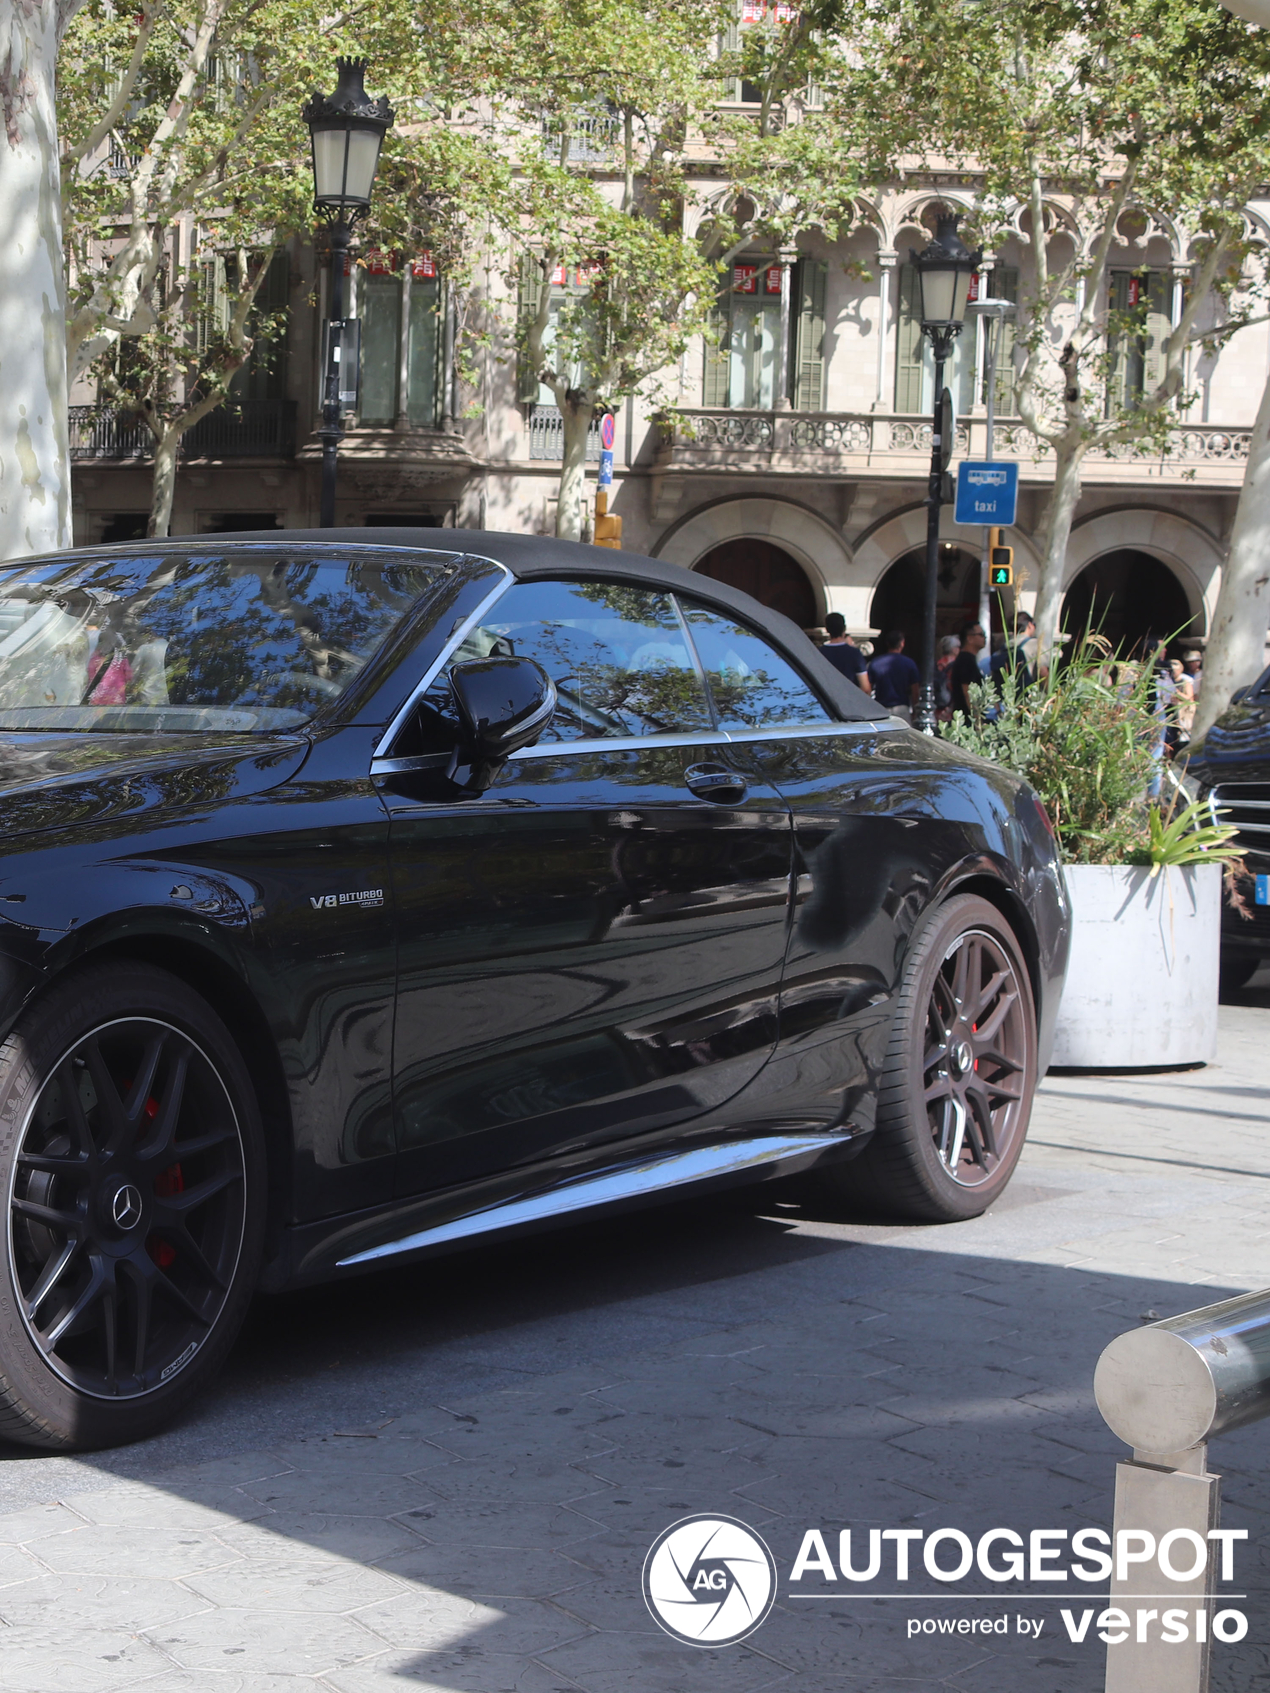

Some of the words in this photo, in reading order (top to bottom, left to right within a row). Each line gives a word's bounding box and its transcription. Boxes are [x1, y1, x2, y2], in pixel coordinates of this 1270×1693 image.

[974, 500, 997, 513] taxi
[310, 895, 337, 910] V8
[339, 889, 384, 903] BITURBO
